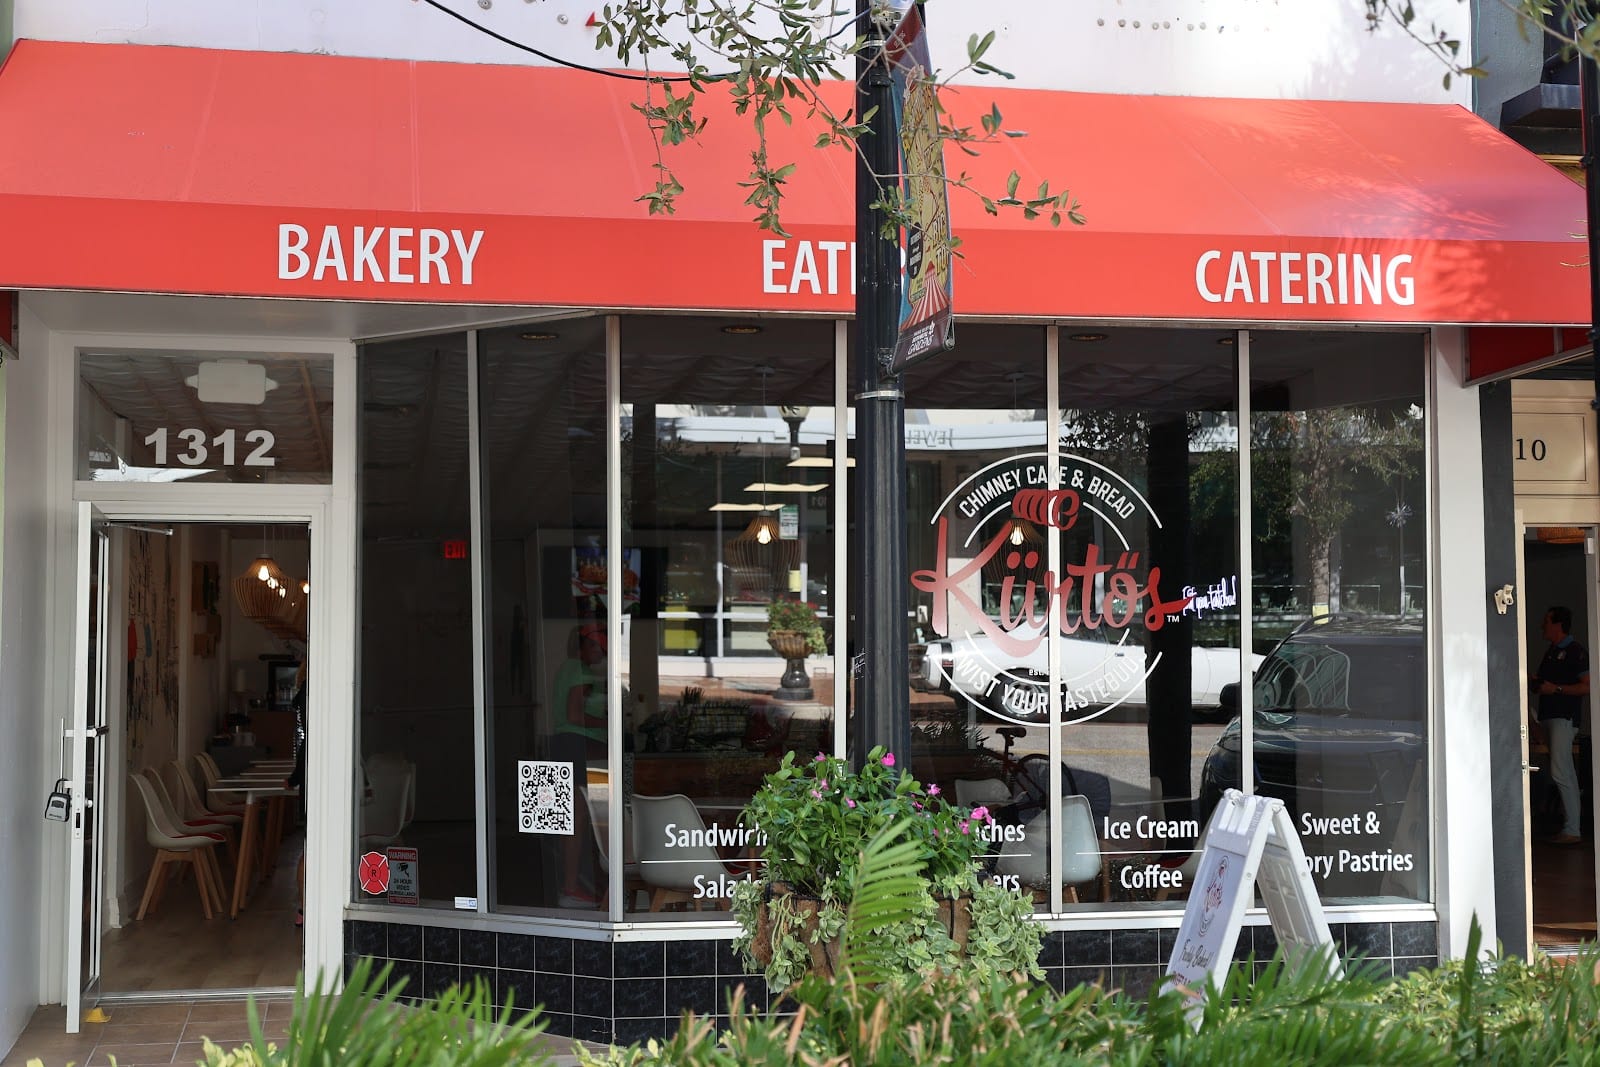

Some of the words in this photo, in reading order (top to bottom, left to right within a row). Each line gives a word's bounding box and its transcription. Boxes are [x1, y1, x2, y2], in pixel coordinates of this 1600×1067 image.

[278, 223, 485, 285] BAKERY
[1195, 250, 1415, 305] CATERING
[144, 427, 276, 467] 1312
[1515, 438, 1546, 461] 10
[958, 468, 1021, 518] CHIMNEY
[1026, 465, 1068, 485] CAKE
[1070, 468, 1085, 490] &
[1087, 476, 1136, 520] BREAD
[1166, 615, 1180, 623] TM
[1001, 684, 1049, 714] YOUR
[1058, 651, 1147, 712] TASTEBUD
[1103, 816, 1134, 839] Ice
[1136, 815, 1199, 839] Cream
[1301, 812, 1361, 836] Sweet
[1364, 811, 1381, 835] &
[371, 869, 377, 877] R
[1338, 848, 1414, 873] Pastries
[1120, 864, 1183, 889] Coffee
